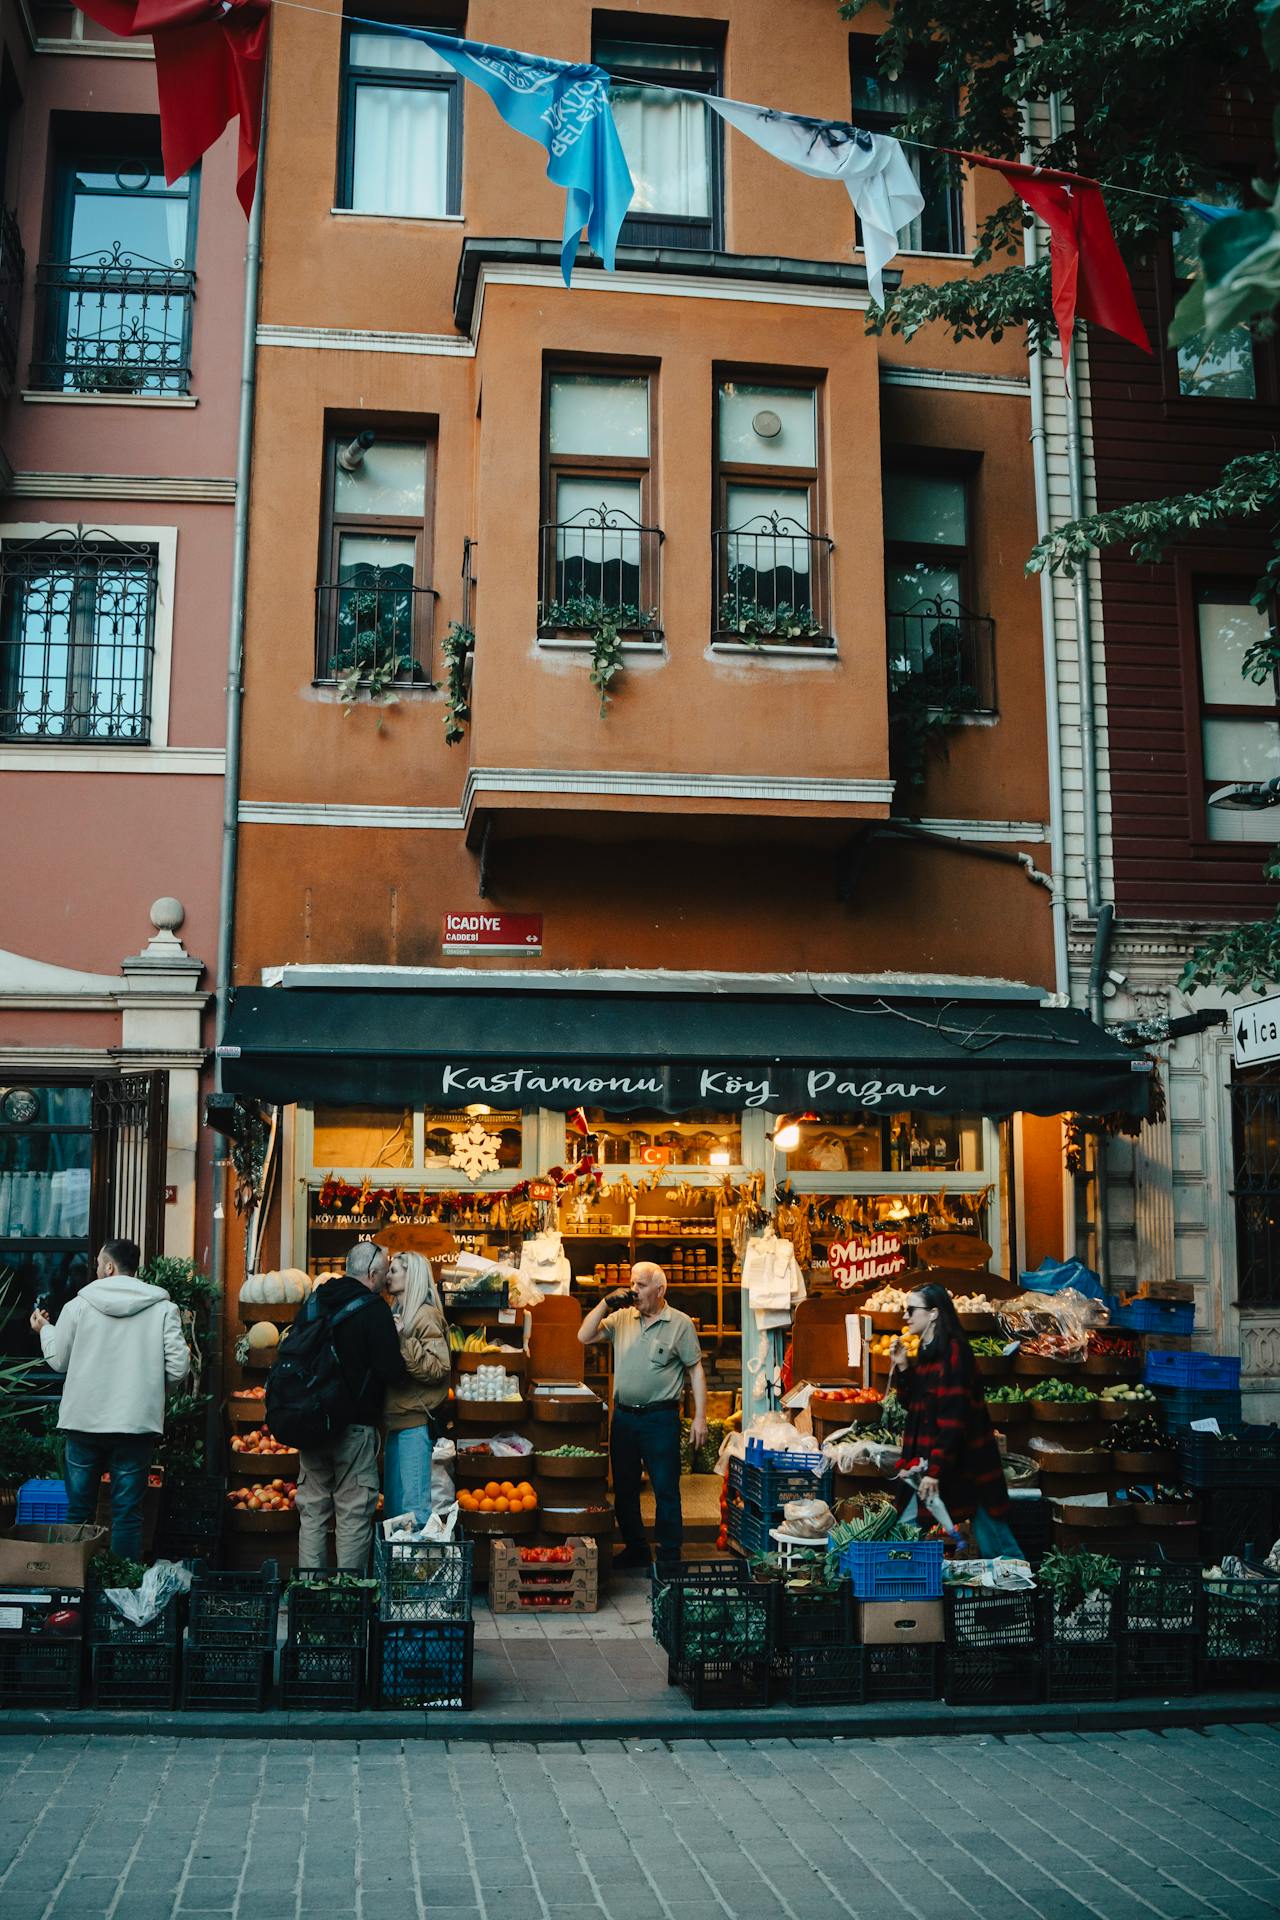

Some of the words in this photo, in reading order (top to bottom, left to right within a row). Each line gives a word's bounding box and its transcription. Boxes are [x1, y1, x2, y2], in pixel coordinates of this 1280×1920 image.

[447, 914, 501, 931] İCADİYE
[446, 933, 479, 942] CADDESİ
[442, 1065, 664, 1094] Kastamonu
[700, 1069, 780, 1107] Köy
[807, 1070, 947, 1106] Pazarı
[315, 1212, 334, 1224] KÖY
[336, 1212, 375, 1224] TAVUĞU
[830, 1235, 901, 1267] Mutlu
[833, 1256, 906, 1290] Yıllar
